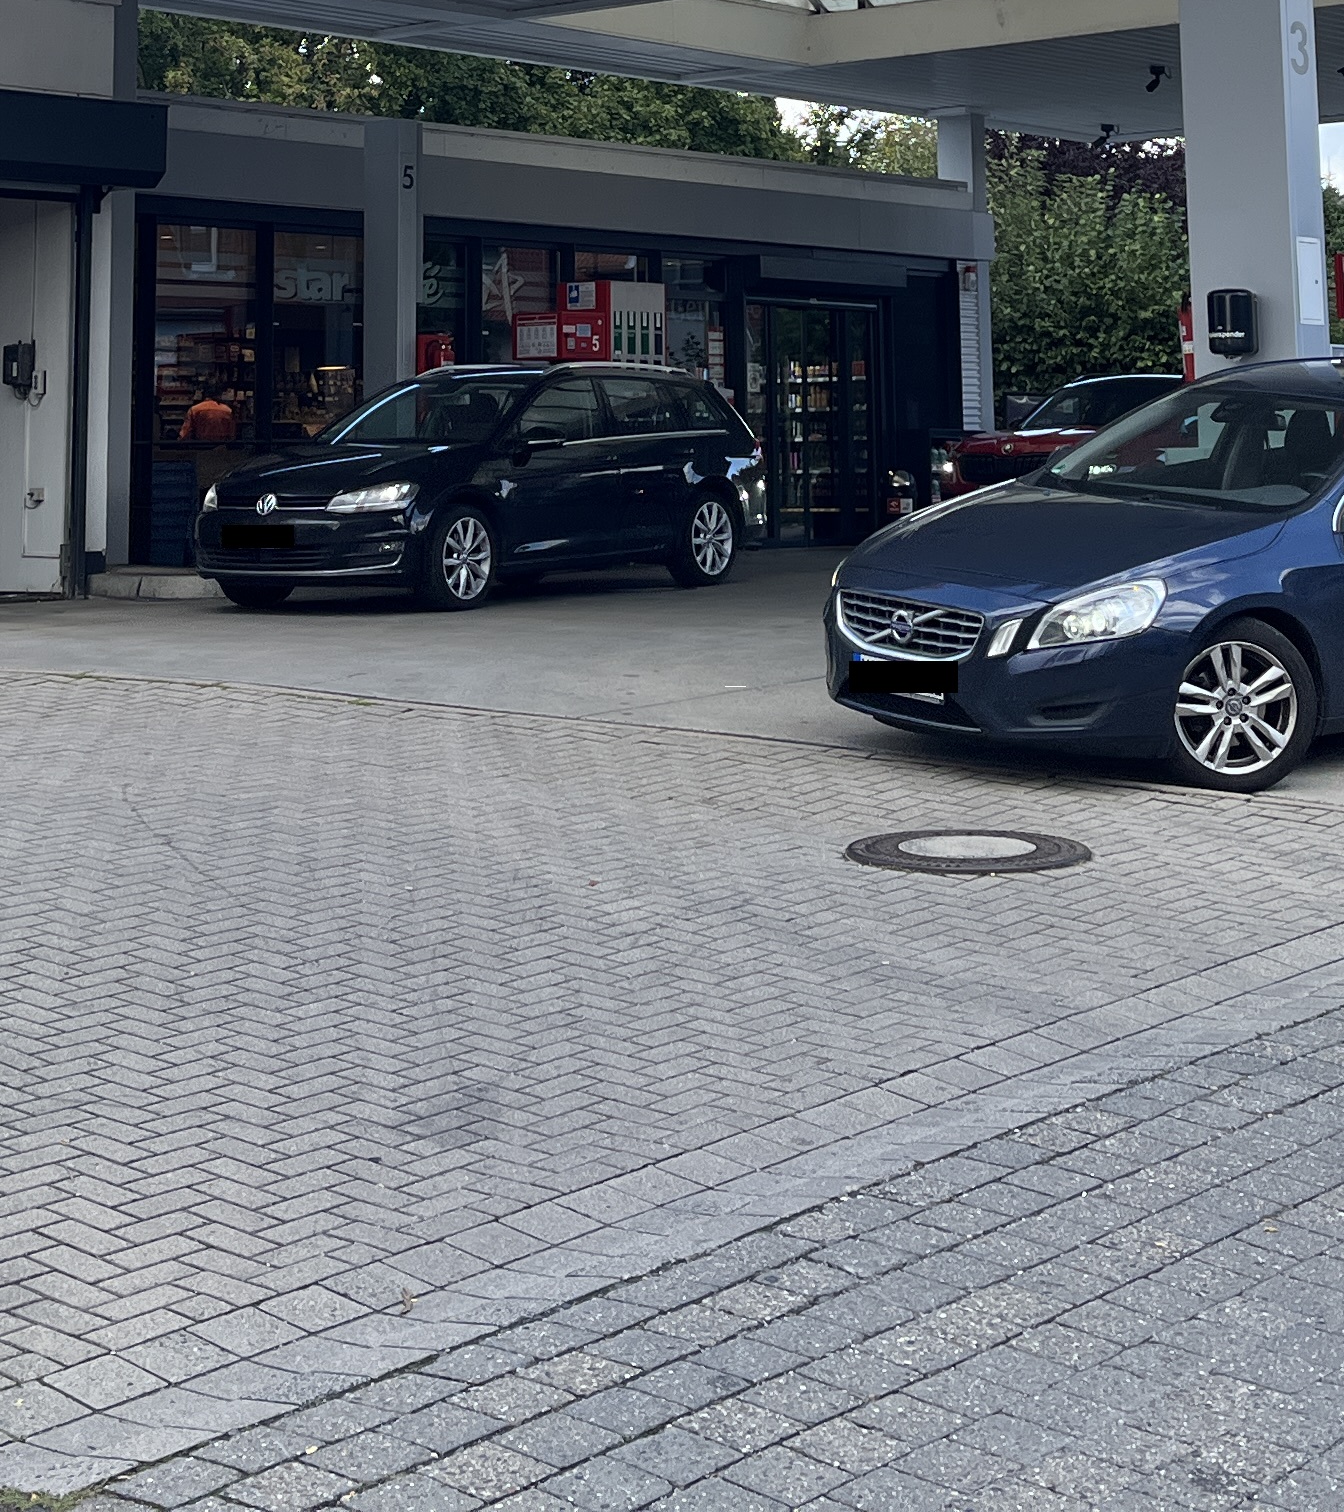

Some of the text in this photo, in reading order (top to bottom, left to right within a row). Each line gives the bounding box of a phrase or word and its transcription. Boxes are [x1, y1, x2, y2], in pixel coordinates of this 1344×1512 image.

[1290, 20, 1309, 75] 3
[402, 164, 414, 189] 5
[274, 264, 350, 301] star
[592, 335, 600, 351] 5
